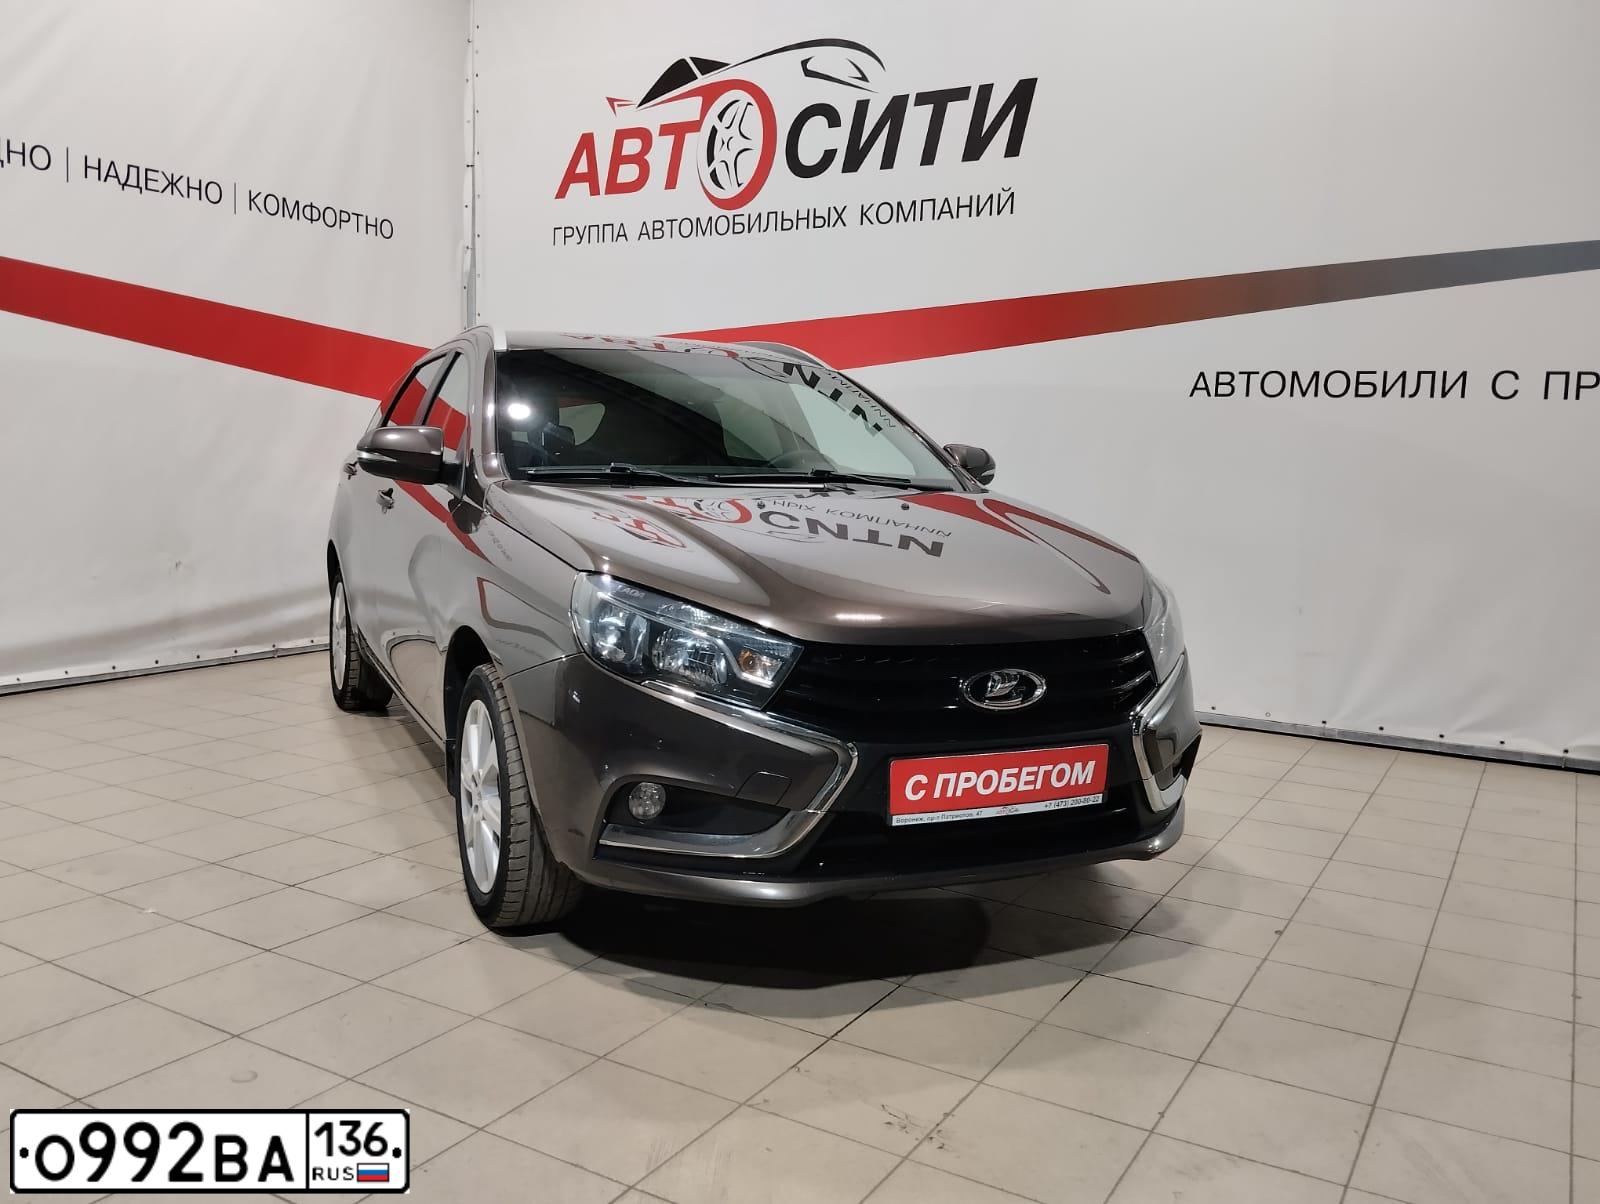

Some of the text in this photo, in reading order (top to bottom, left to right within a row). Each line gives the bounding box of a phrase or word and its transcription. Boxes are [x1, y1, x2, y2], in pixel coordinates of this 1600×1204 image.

[0, 138, 394, 240] НО НАДЕЖНО КОМФОРТНО
[553, 187, 1015, 246] ГРУППА АВТОМОБИЛЬНЫХ КОМПАНИЙ
[1189, 369, 1600, 401] АВТОМОБИЛИ С ПР
[904, 760, 1096, 801] С ПРОБЕГОМ
